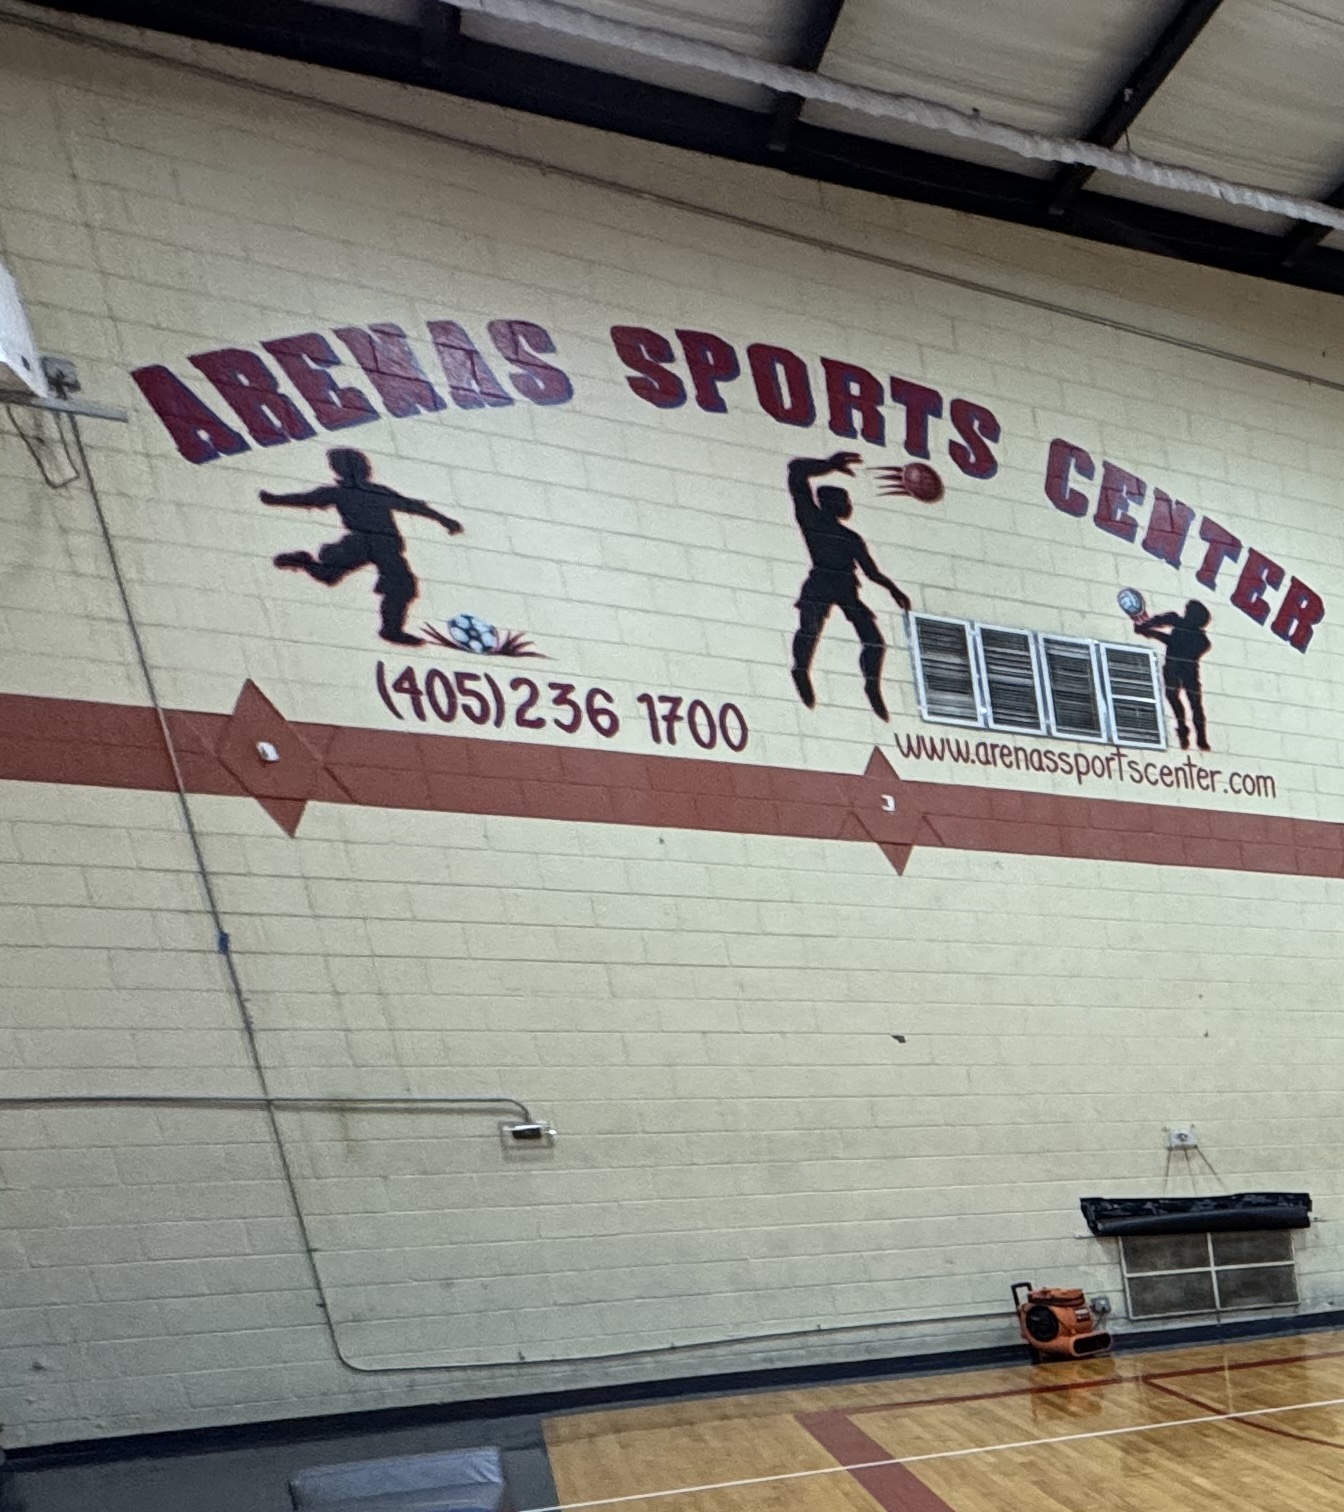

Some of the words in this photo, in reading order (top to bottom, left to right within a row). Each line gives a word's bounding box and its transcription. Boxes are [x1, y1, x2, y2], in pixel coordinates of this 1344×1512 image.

[130, 319, 574, 465] ARENAS
[610, 325, 1001, 480] SPORTS
[1044, 437, 1326, 655] CENTER
[636, 692, 749, 753] 1700
[893, 731, 1277, 800] www.arenassportscenter.com
